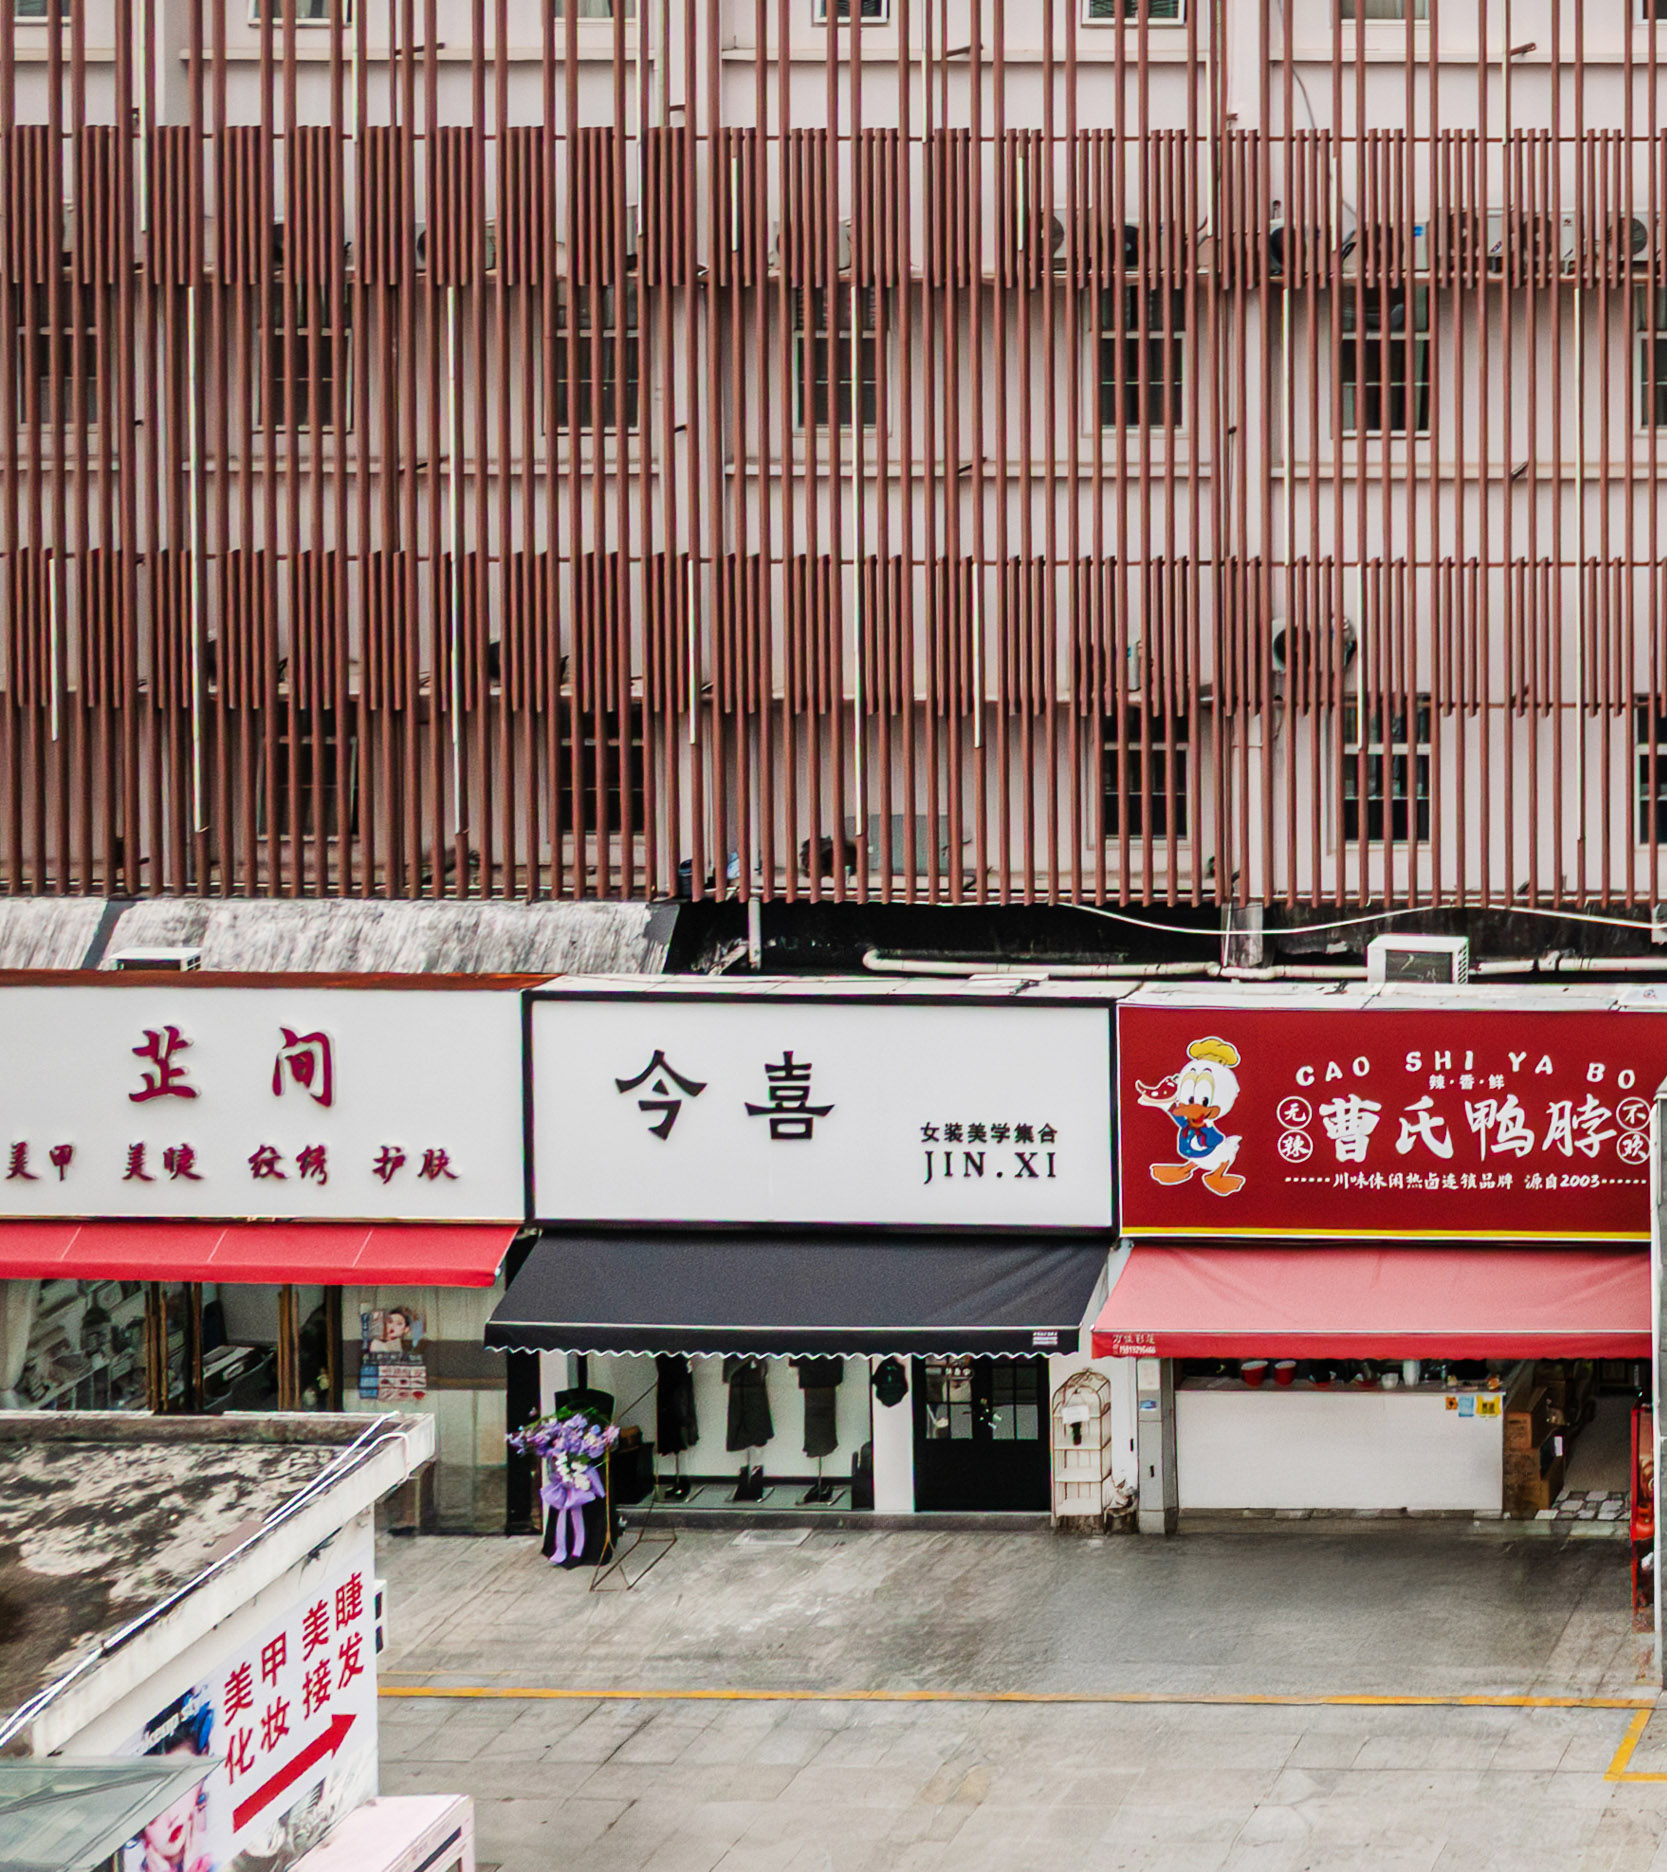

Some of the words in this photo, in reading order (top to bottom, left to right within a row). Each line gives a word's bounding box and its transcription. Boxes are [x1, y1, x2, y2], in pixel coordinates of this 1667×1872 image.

[128, 1027, 332, 1107] 芷间
[615, 1049, 835, 1140] 今喜
[1296, 1056, 1369, 1086] CAO
[1406, 1051, 1473, 1072] SHI
[1508, 1052, 1553, 1074] YA
[1587, 1063, 1635, 1089] BO
[6, 1140, 76, 1181] 美甲
[122, 1142, 204, 1182] 美睫
[247, 1144, 329, 1185] 纹绣
[372, 1145, 459, 1185] 护肤
[921, 1122, 1057, 1143] 女装美学集合
[1319, 1094, 1617, 1162] 曹氏鸭脖
[224, 1630, 287, 1726] 美甲
[302, 1572, 363, 1662] 美睫
[224, 1695, 290, 1785] 化妆
[302, 1632, 364, 1720] 接发
